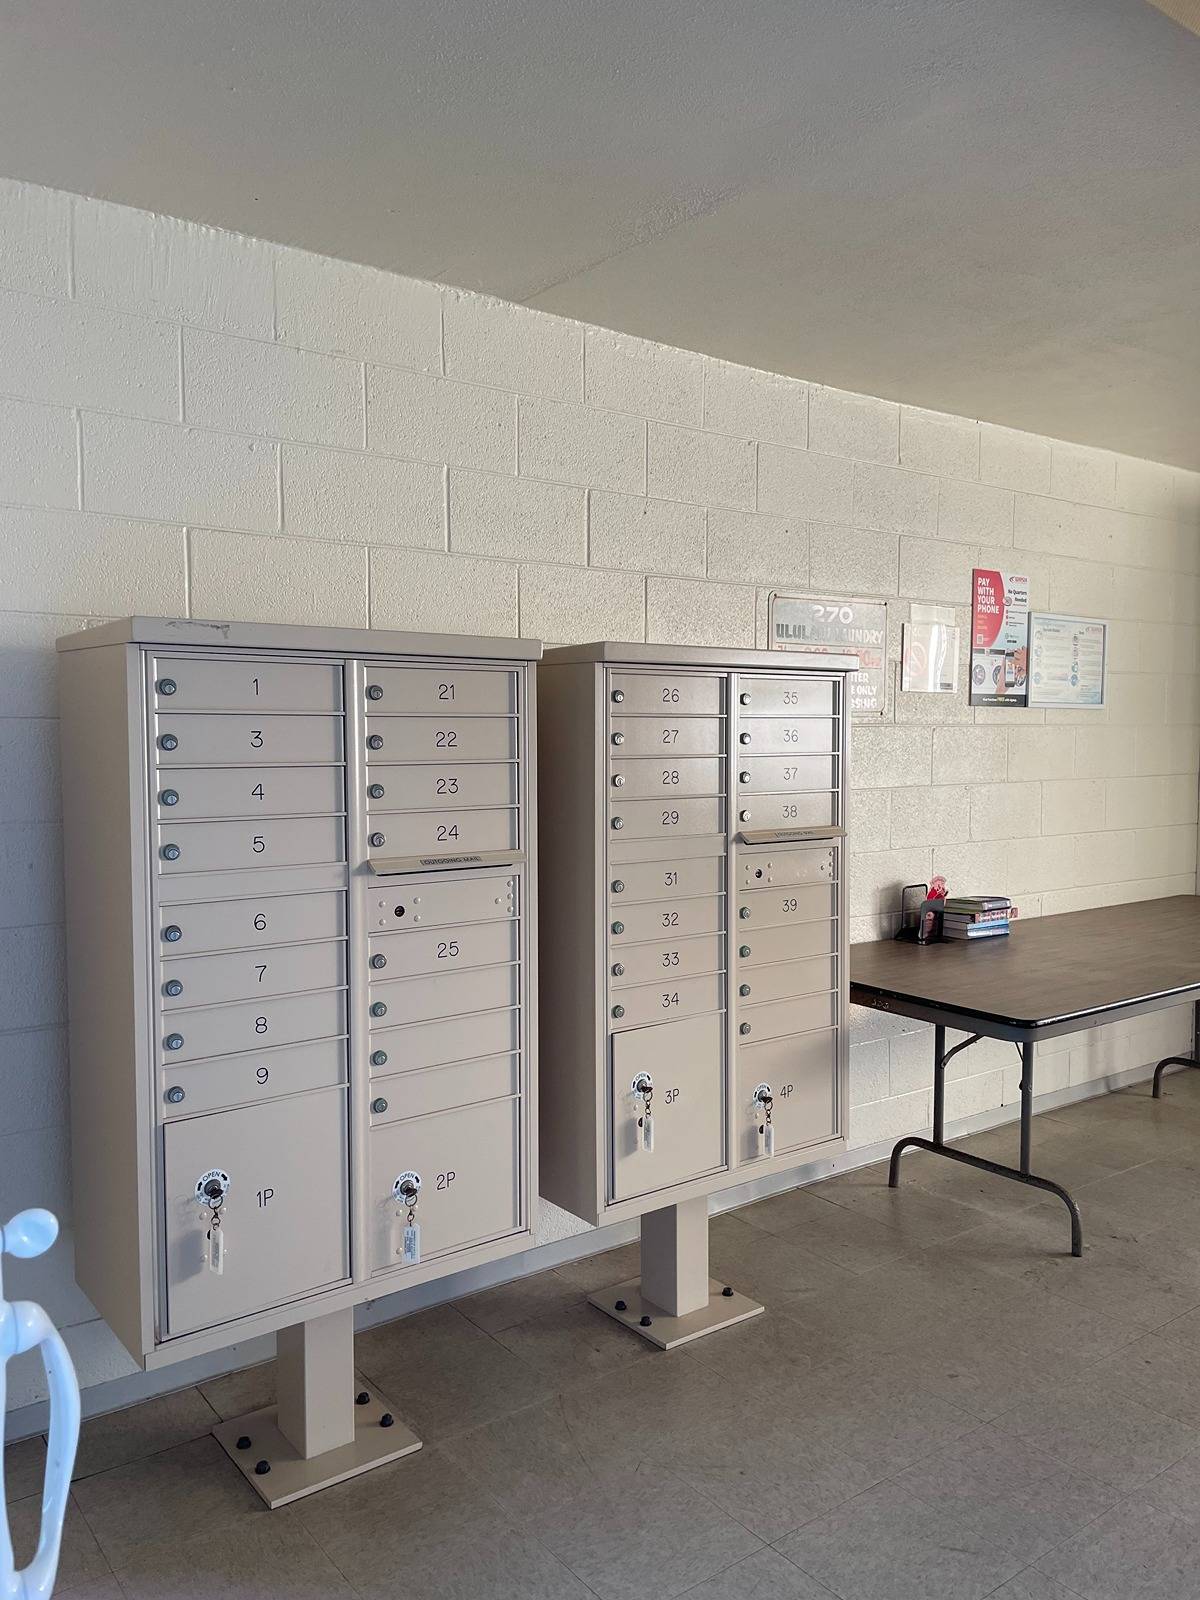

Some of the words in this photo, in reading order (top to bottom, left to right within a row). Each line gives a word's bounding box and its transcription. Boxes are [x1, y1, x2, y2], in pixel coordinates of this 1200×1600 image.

[977, 577, 990, 587] PAY
[977, 587, 995, 595] WITH
[977, 595, 995, 605] YOUR
[812, 604, 854, 624] 270
[977, 604, 1000, 614] PHONE
[252, 679, 259, 696] 1
[438, 683, 457, 700] 21
[662, 687, 680, 703] 26
[856, 685, 878, 696] ONLY
[783, 691, 799, 705] 35
[250, 730, 264, 749] 3
[435, 731, 458, 748] 22
[662, 729, 679, 744] 27
[783, 729, 799, 743] 36
[662, 770, 680, 785] 28
[783, 767, 798, 781] 37
[251, 783, 265, 801] 4
[436, 778, 459, 795] 23
[661, 810, 680, 826] 29
[782, 804, 798, 819] 38
[436, 824, 460, 842] 24
[252, 835, 266, 854] 5
[664, 871, 678, 887] 31
[782, 898, 798, 913] 39
[253, 913, 267, 931] 6
[661, 911, 679, 928] 32
[437, 940, 460, 959] 25
[662, 951, 680, 968] 33
[254, 964, 267, 983] 7
[661, 992, 680, 1008] 34
[255, 1016, 268, 1034] 8
[256, 1067, 269, 1085] 9
[664, 1088, 680, 1105] 3P
[779, 1084, 794, 1099] 4P
[202, 1171, 221, 1181] OPEN
[399, 1172, 415, 1181] OPEN
[436, 1171, 456, 1191] 2P
[256, 1188, 274, 1208] 1P
